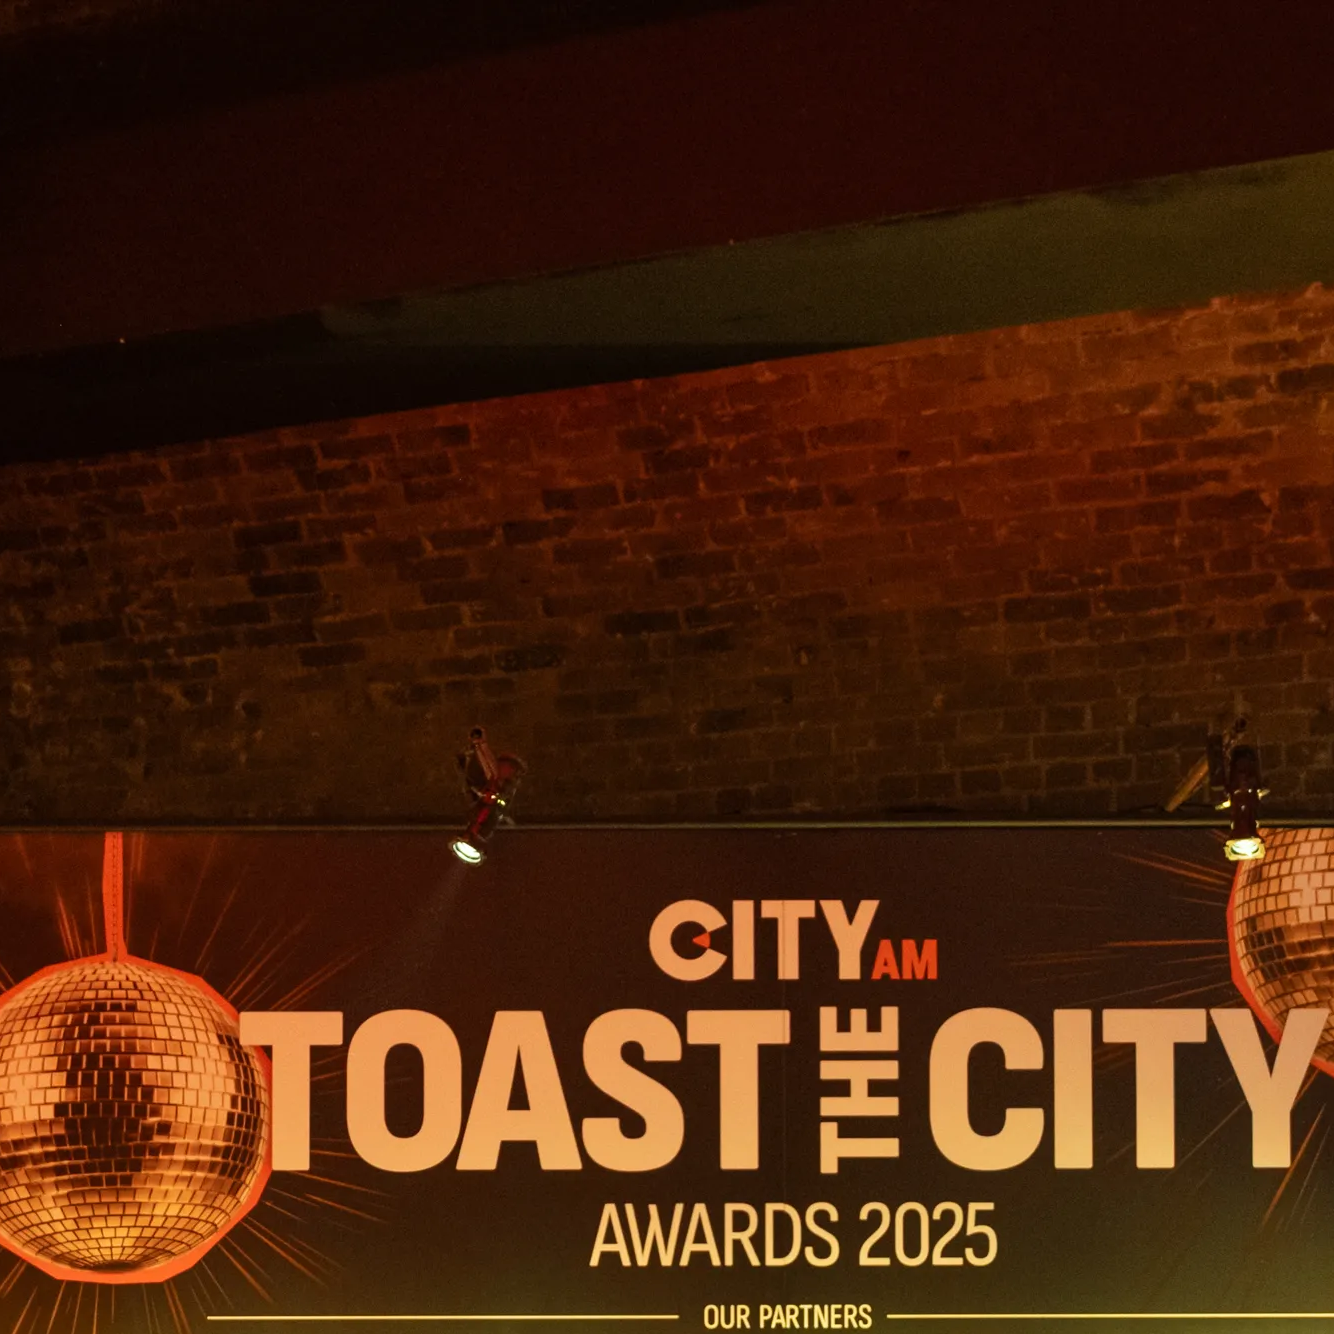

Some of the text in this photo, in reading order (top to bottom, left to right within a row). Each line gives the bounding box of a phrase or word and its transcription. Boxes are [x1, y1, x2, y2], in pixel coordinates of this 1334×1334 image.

[649, 899, 938, 981] CITY AM
[239, 1005, 1330, 1174] TOAST THE CITY
[589, 1202, 998, 1268] AWARDS 2025
[703, 1303, 873, 1330] OUR PARTNERS
